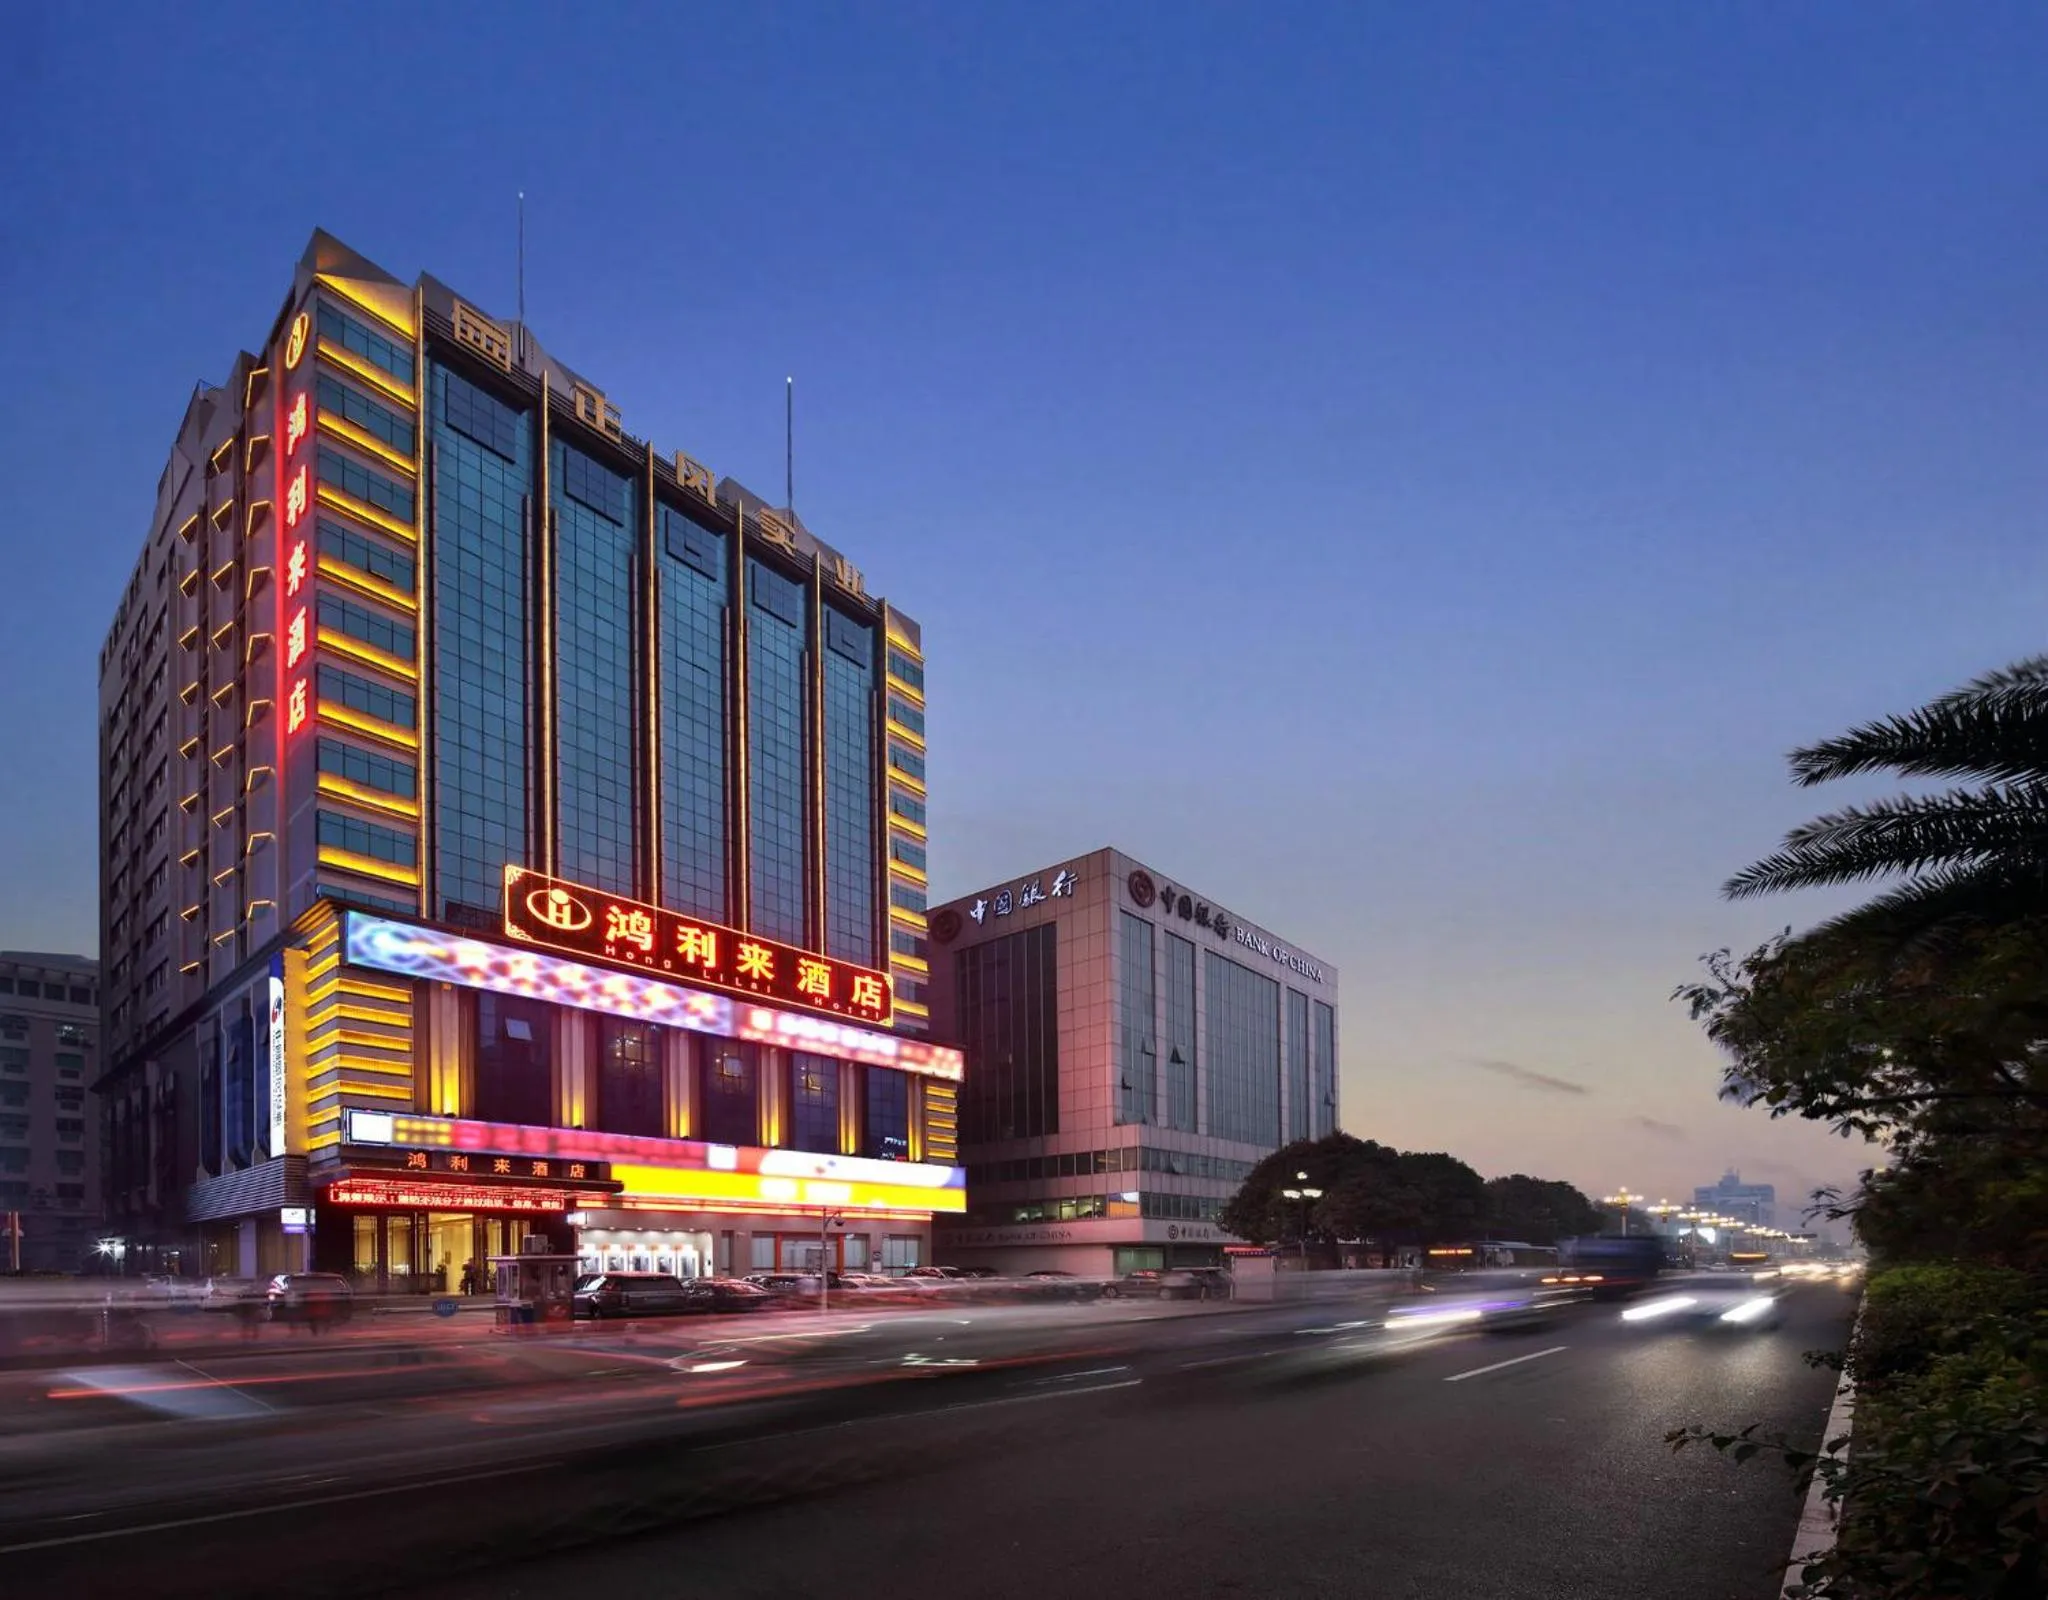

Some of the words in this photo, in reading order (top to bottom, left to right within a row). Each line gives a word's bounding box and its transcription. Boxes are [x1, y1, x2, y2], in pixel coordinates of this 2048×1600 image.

[287, 391, 307, 735] 鸿利来酒店
[969, 869, 1079, 926] 中国银行
[1159, 885, 1230, 941] 中国银行
[605, 904, 883, 1010] 鸿利来酒店
[605, 945, 672, 969] Hong
[814, 997, 879, 1020] Hotel
[1235, 926, 1268, 957] BANK
[1272, 946, 1288, 966] OF
[1288, 955, 1324, 984] CHINA
[407, 1152, 585, 1179] 鸿利来酒店
